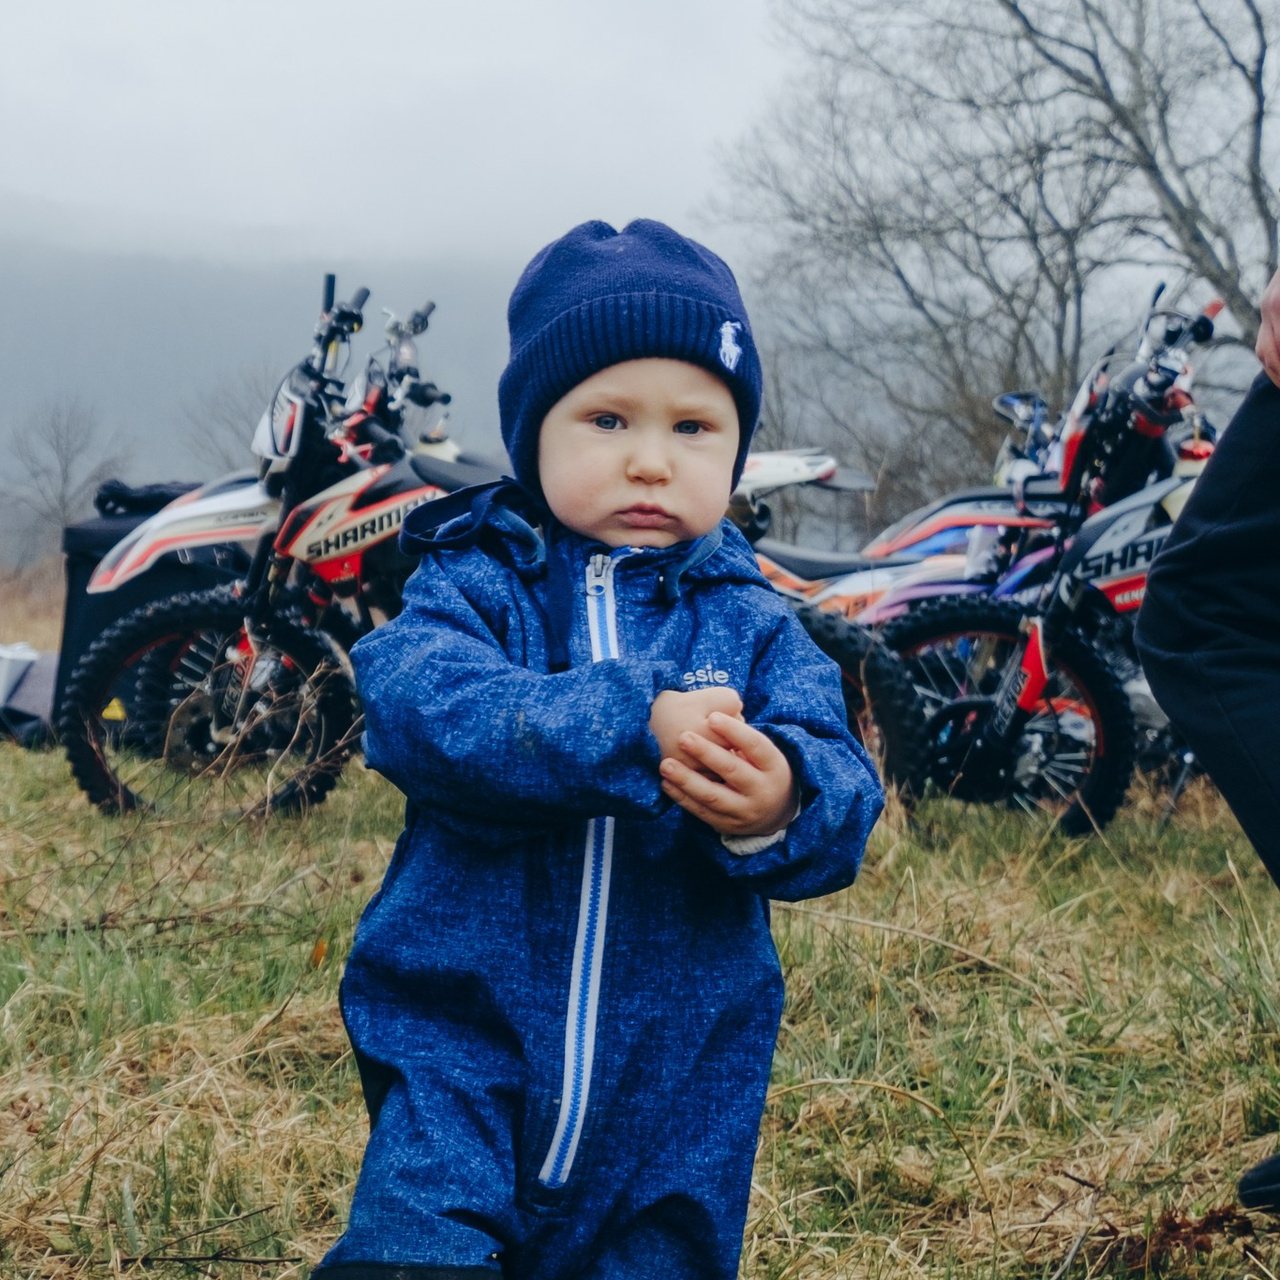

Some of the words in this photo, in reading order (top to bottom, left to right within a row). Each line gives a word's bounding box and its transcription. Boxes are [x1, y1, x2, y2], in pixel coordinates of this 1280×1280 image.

[306, 490, 436, 558] SHARM
[1079, 539, 1163, 580] SHA
[683, 664, 729, 684] ssie
